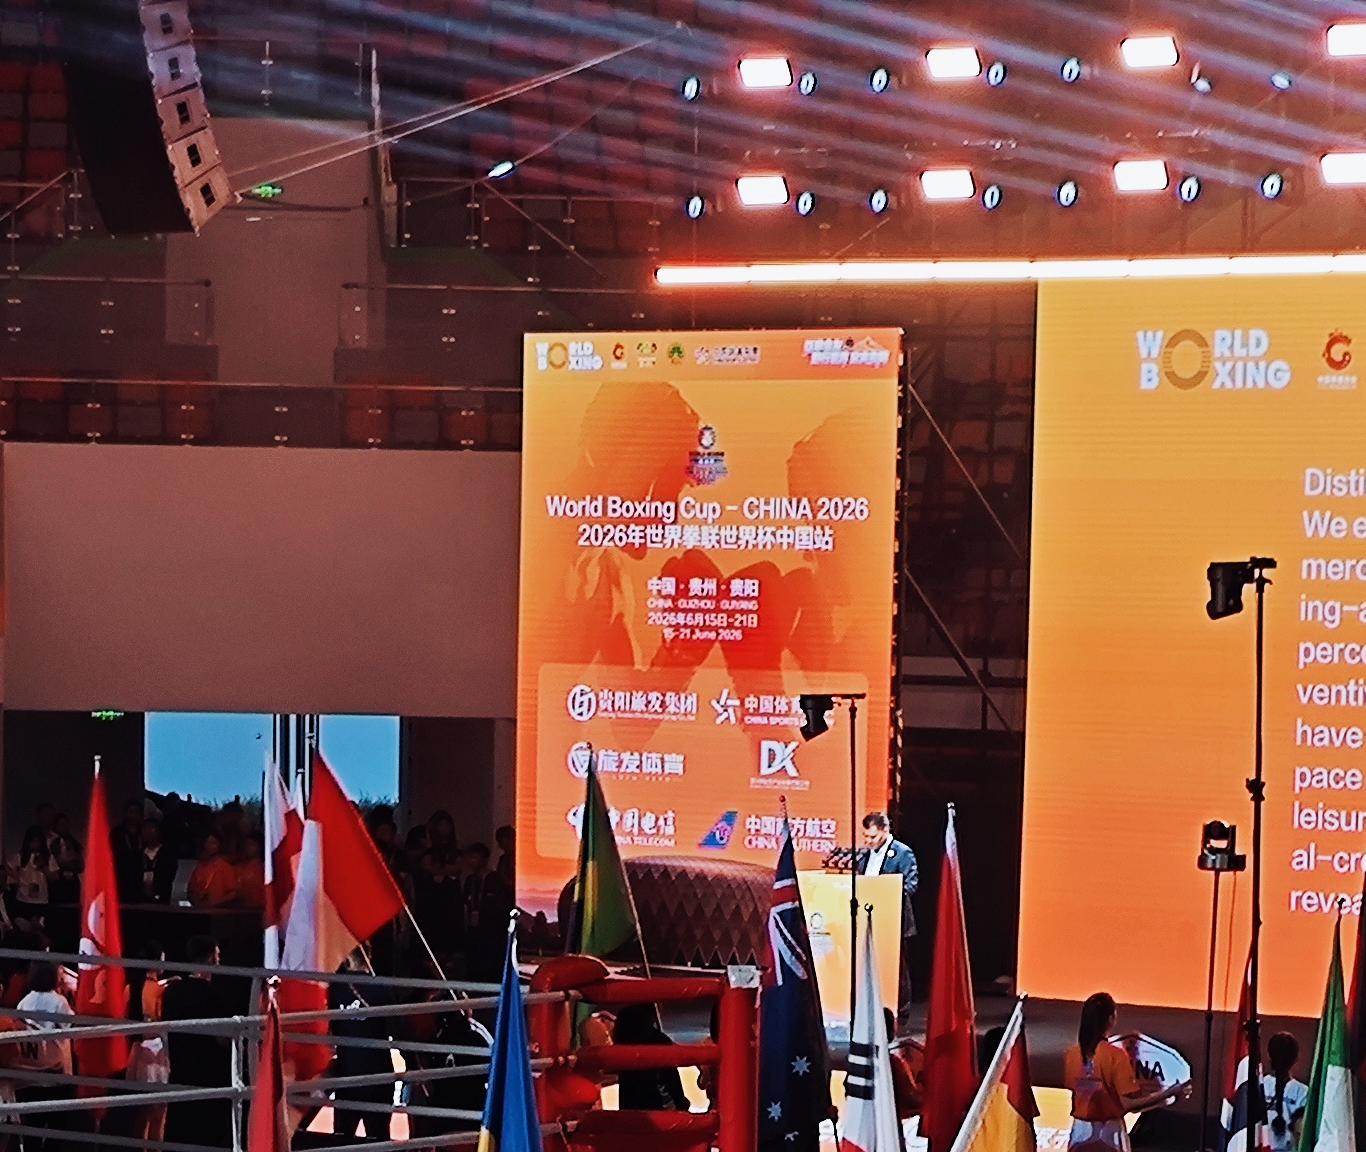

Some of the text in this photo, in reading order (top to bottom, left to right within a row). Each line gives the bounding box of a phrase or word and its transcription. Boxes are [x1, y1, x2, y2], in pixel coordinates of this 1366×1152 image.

[545, 495, 603, 518] World
[607, 496, 676, 522] Boxing
[679, 497, 721, 523] Cup
[742, 497, 813, 520] CHINA
[816, 497, 869, 521] 2026
[1302, 510, 1348, 539] We
[692, 629, 716, 641] June
[717, 629, 743, 641] 2026
[1296, 717, 1364, 749] have
